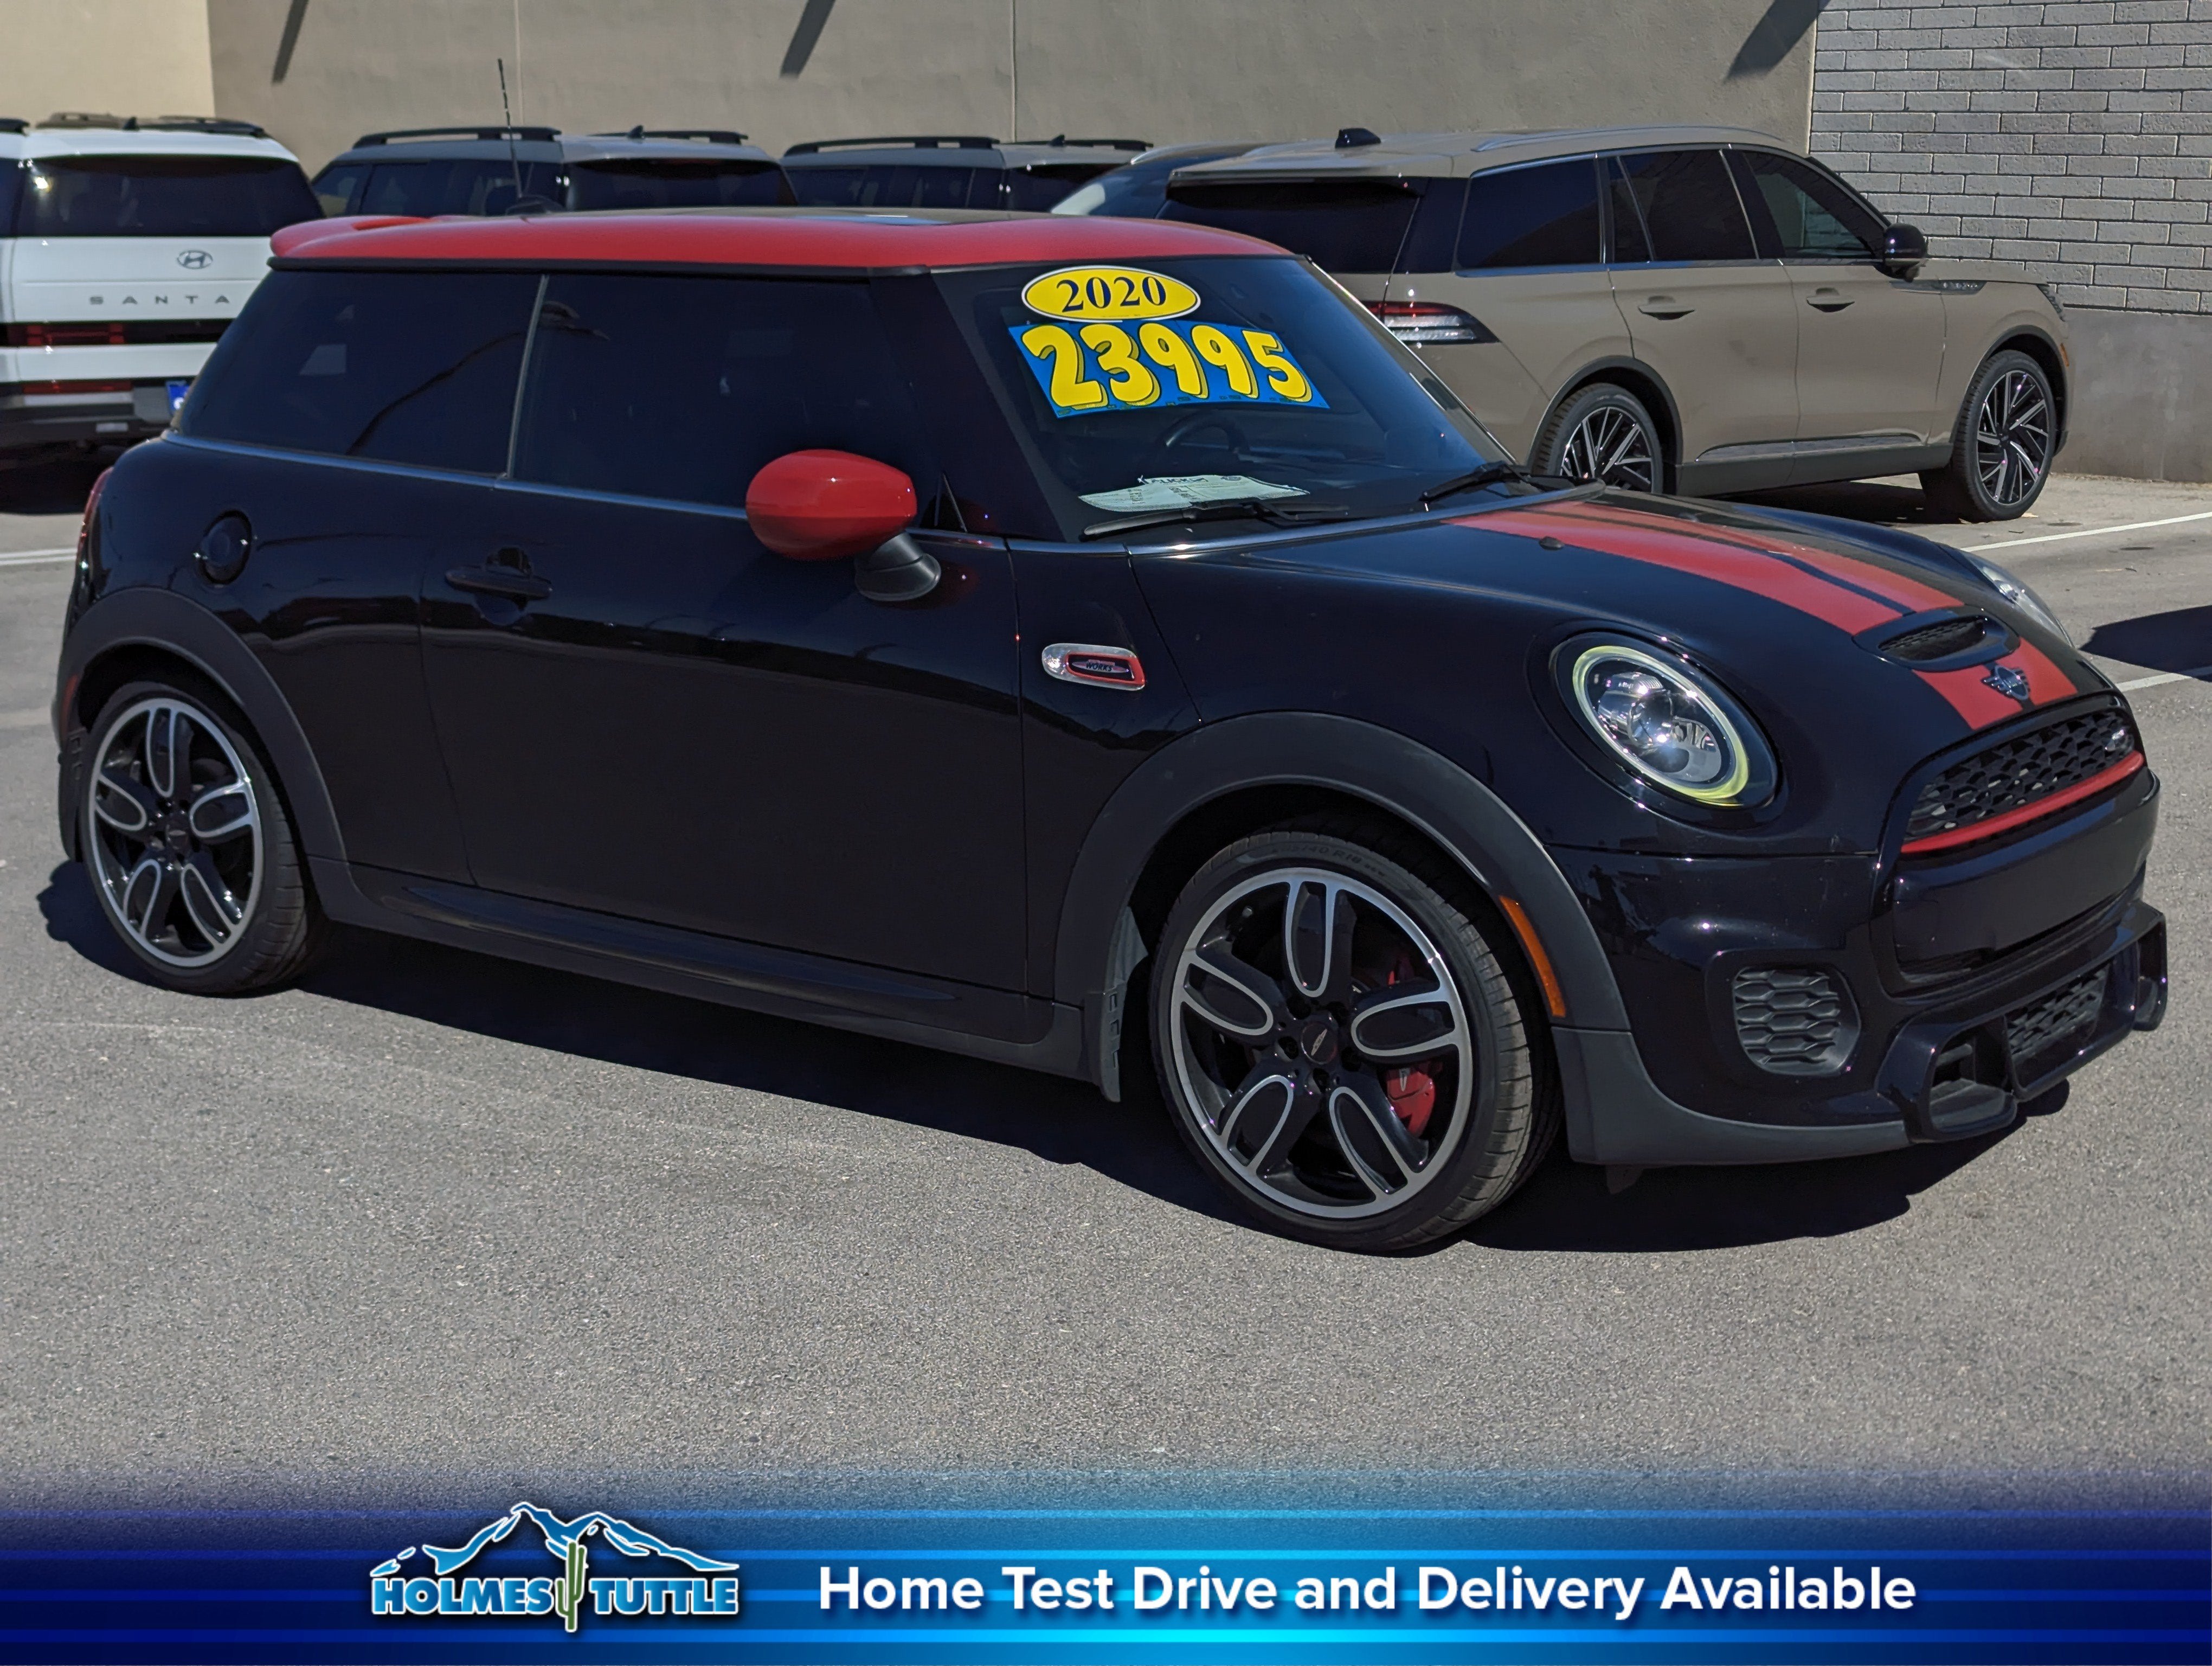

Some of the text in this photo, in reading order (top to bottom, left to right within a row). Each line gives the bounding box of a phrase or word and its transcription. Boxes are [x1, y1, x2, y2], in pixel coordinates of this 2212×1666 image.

[89, 294, 230, 305] SANTA
[1056, 275, 1167, 313] 2020
[1021, 323, 1313, 410] 23995
[1086, 662, 1113, 672] WORKS
